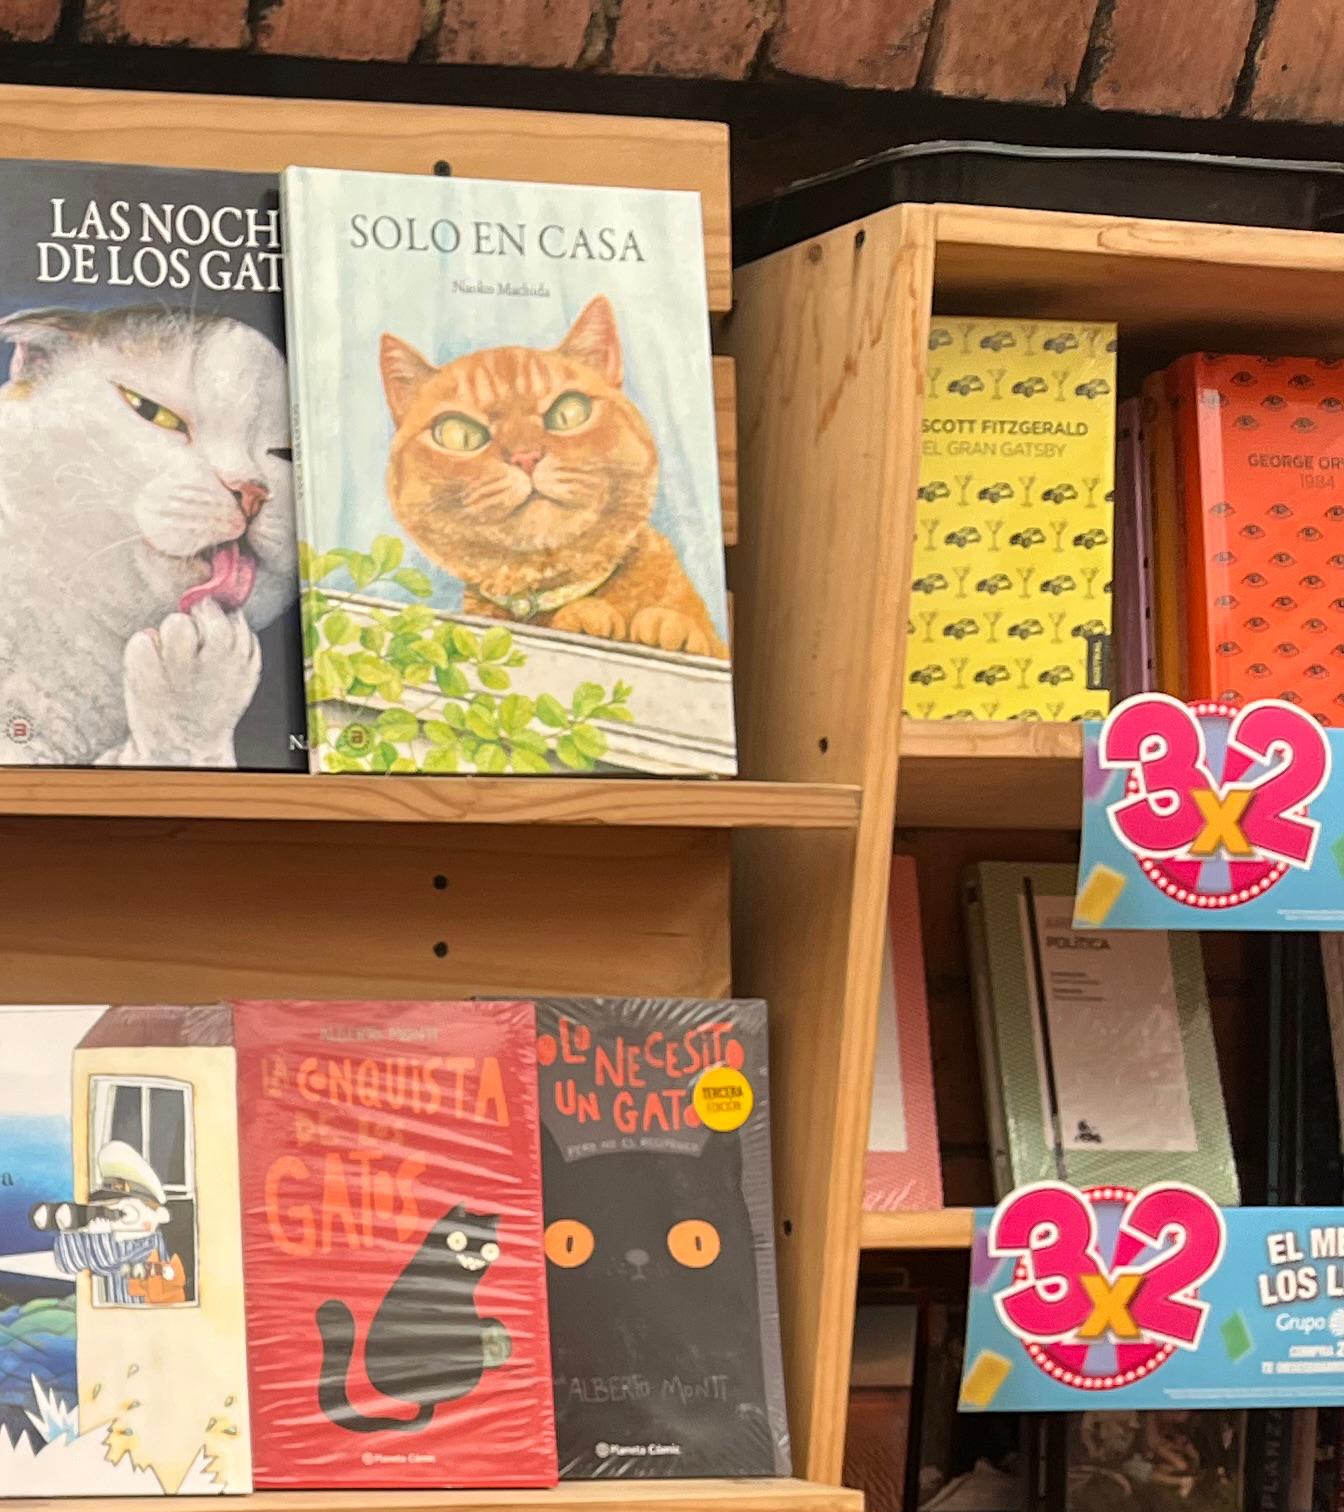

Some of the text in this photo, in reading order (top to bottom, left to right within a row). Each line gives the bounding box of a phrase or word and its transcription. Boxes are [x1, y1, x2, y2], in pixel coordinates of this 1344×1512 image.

[50, 198, 131, 241] LAS
[350, 214, 646, 263] SOLO EN CASA
[36, 242, 190, 289] DE LOS
[922, 418, 1089, 436] SCOTT FITZGERALD
[922, 440, 1068, 458] EL GRAN GATSBY
[1247, 453, 1313, 469] GEORGE
[555, 1079, 703, 1134] UN GATO
[264, 1150, 429, 1258] GATOS
[1267, 1231, 1304, 1265] EL
[1258, 1266, 1318, 1306] LOS
[1275, 1313, 1326, 1335] Grupo
